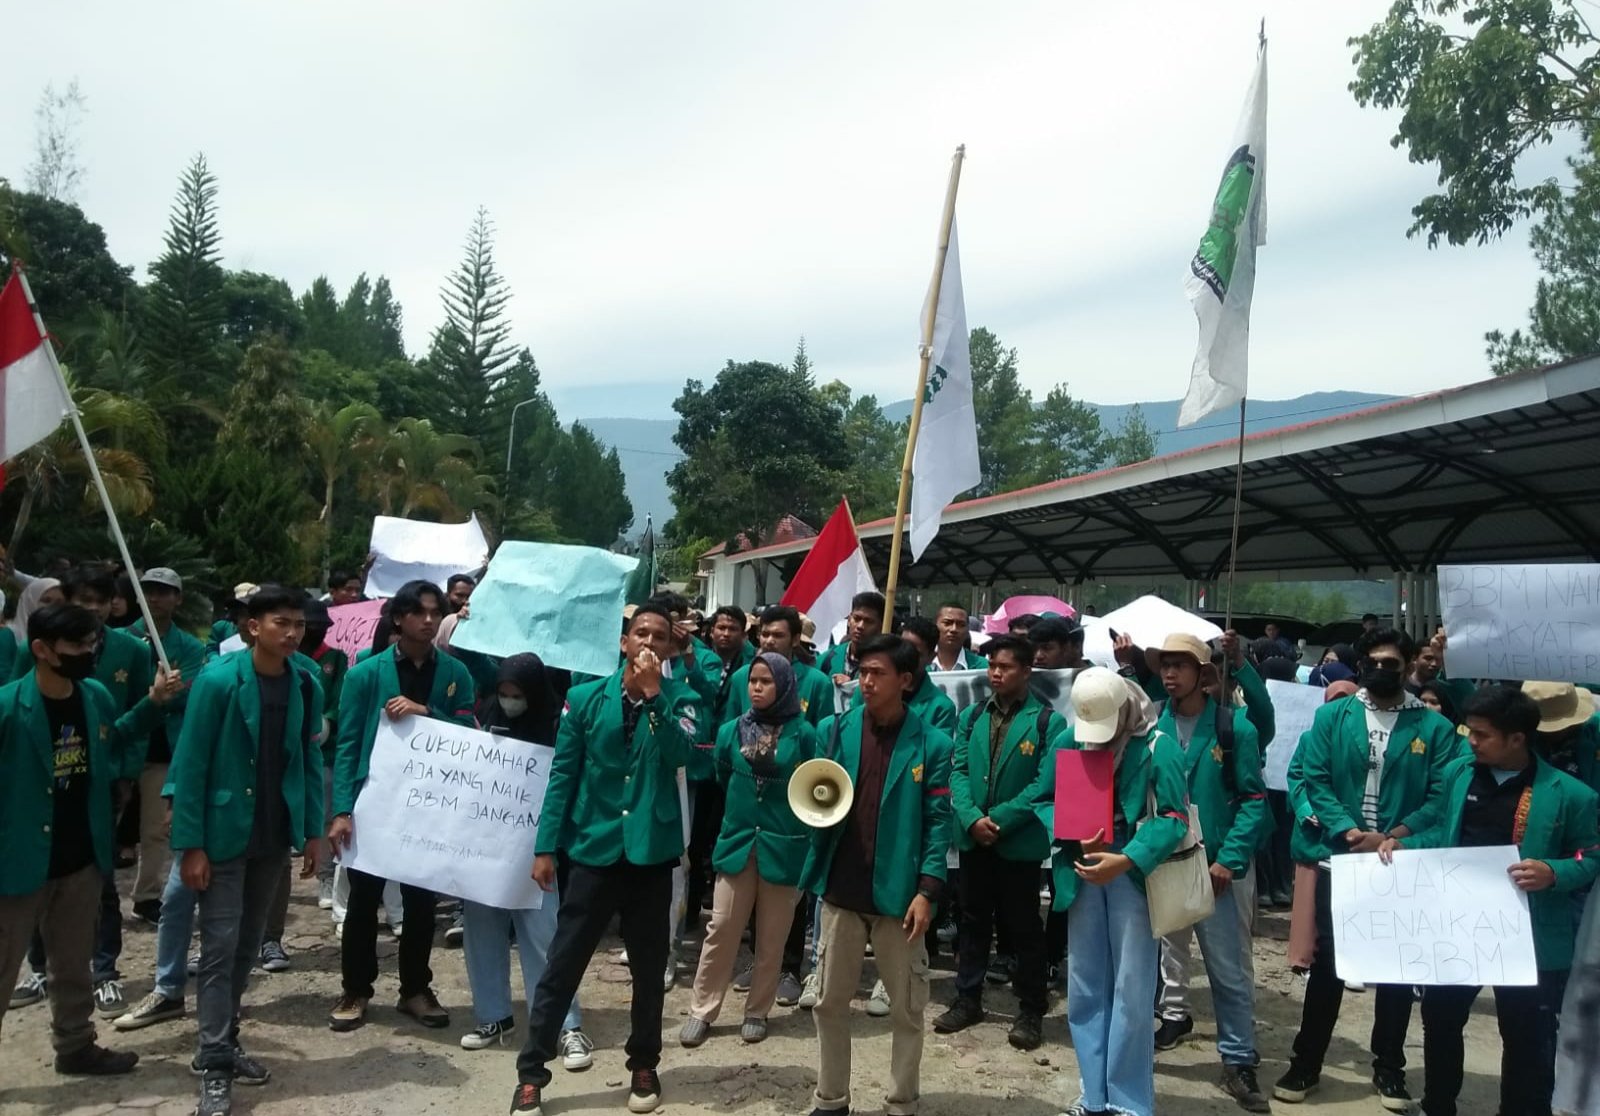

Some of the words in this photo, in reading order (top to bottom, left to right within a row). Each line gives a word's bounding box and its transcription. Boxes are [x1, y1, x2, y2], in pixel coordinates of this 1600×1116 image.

[1442, 566, 1531, 610] BBM
[1458, 617, 1591, 651] RAKYAT
[410, 731, 471, 760] CUKUP
[475, 744, 540, 776] MAHAR
[403, 759, 433, 780] AJA
[440, 768, 483, 792] YANG
[491, 780, 532, 804] NAIK
[406, 788, 460, 811] BBM
[468, 801, 541, 829] JANGAN
[1344, 857, 1472, 898] TOLAK
[1342, 909, 1521, 941] KENAIKAN
[1398, 941, 1505, 984] BBM
